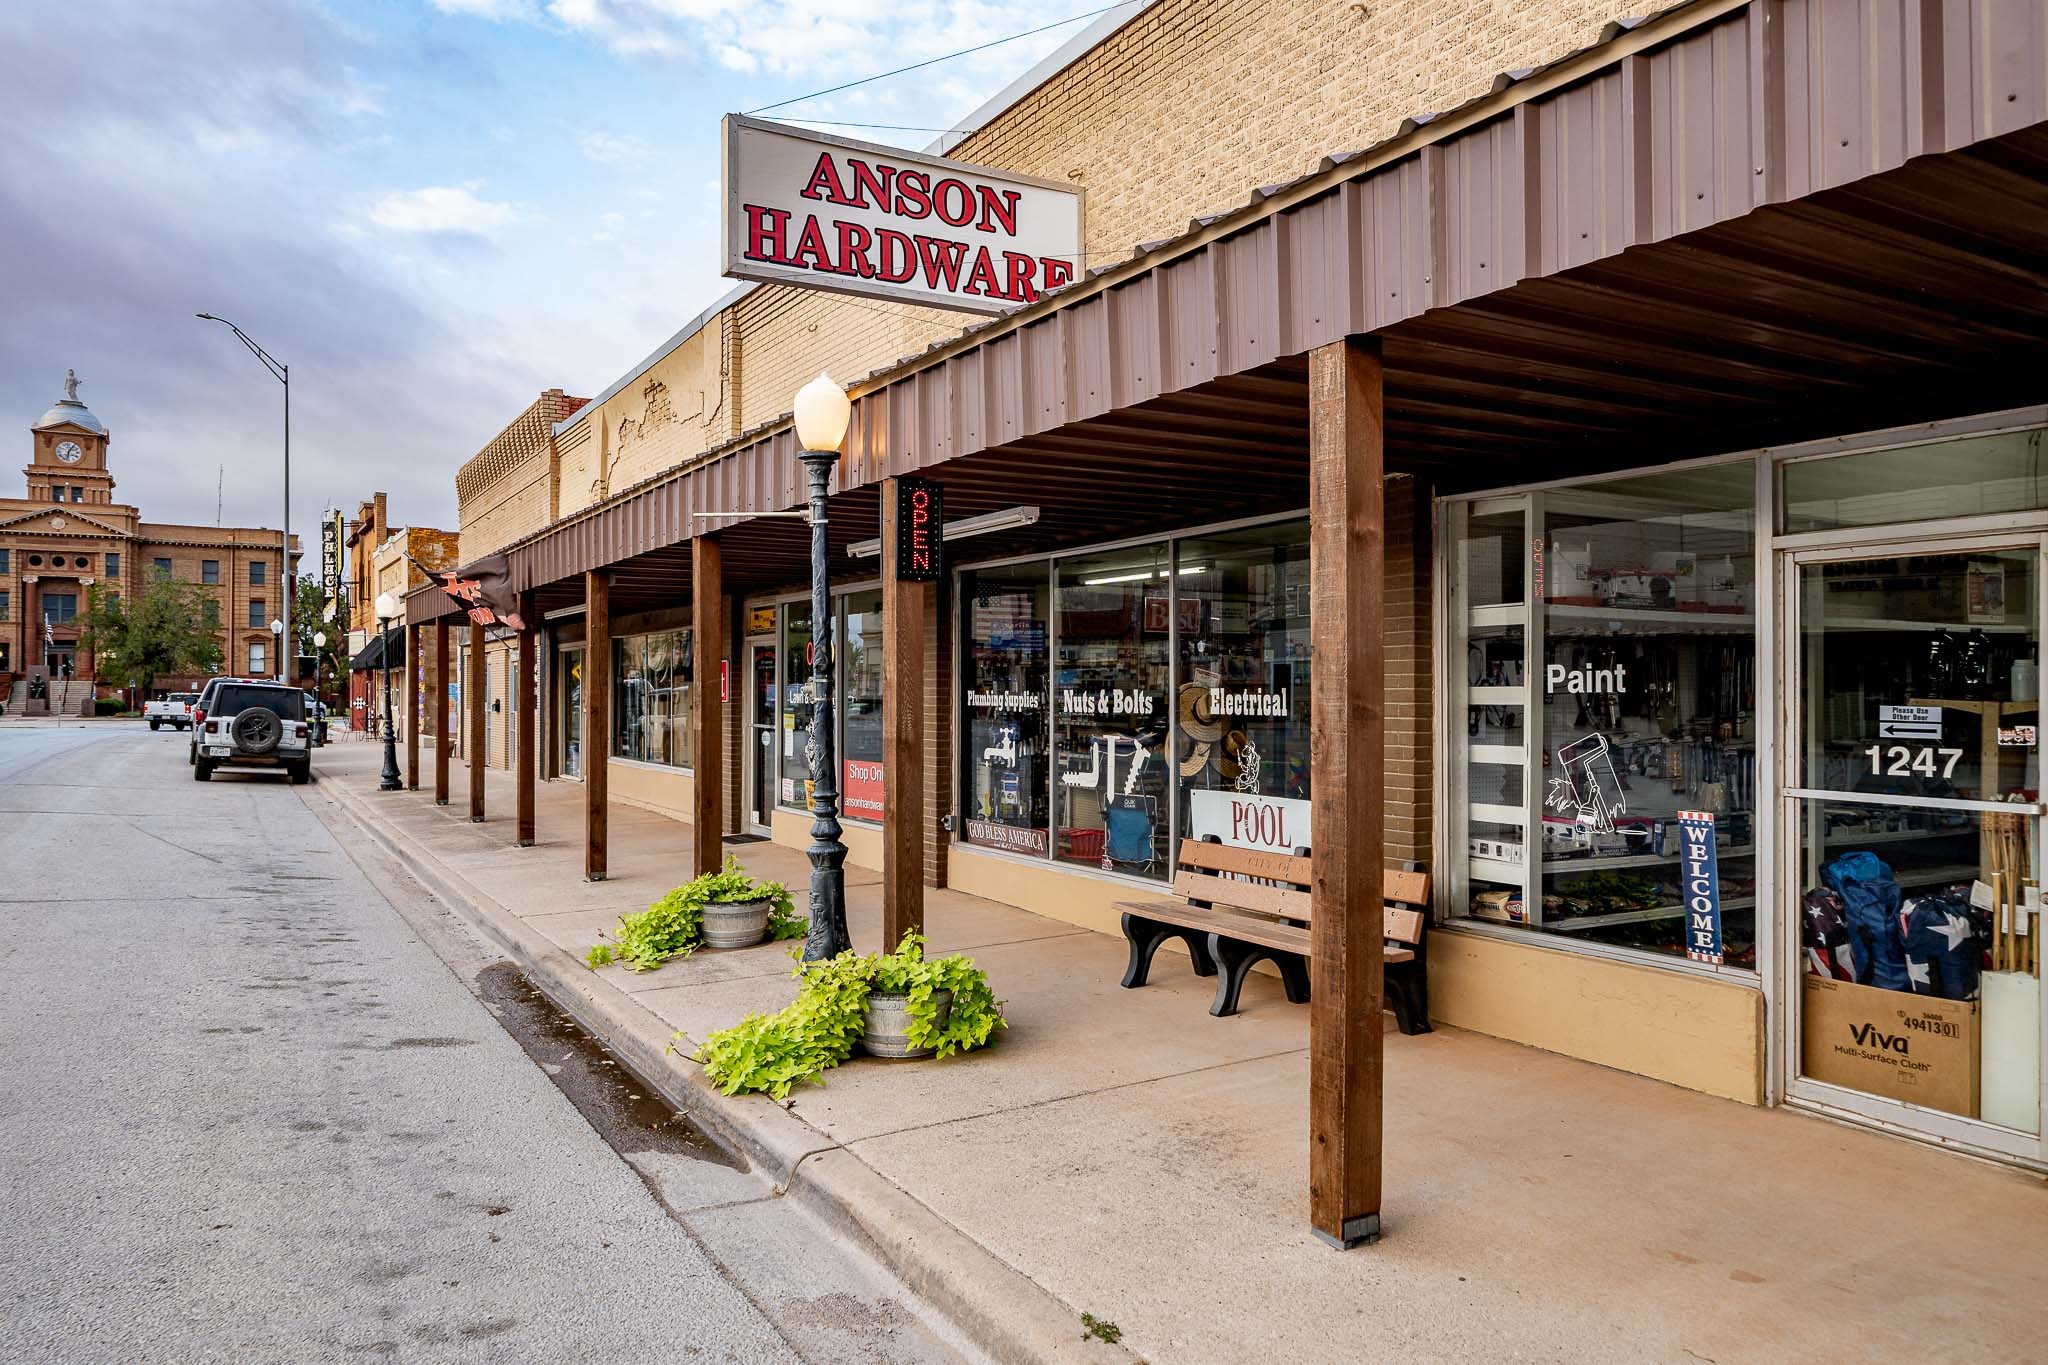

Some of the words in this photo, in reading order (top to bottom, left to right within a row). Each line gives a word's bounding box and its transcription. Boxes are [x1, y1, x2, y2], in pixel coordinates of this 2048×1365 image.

[801, 151, 1021, 236] ANSON
[912, 490, 929, 570] OPEN
[324, 531, 335, 598] PALACE
[1547, 662, 1626, 694] Paint
[967, 690, 1004, 710] Plumbing
[1004, 690, 1039, 712] Supplies
[1064, 689, 1095, 713] Nuts
[1097, 689, 1109, 714] &
[1113, 689, 1153, 714] Bolts
[1210, 688, 1287, 717] Electrical
[1892, 706, 1913, 714] Please
[1916, 707, 1929, 715] Use
[849, 763, 869, 784] Shop
[870, 766, 884, 782] Onl
[1865, 745, 1963, 779] 1247
[969, 822, 985, 838] GOD
[985, 825, 1007, 842] BLESS
[1008, 829, 1044, 851] AMERICA
[1231, 801, 1292, 848] POOL
[1686, 826, 1714, 948] WELCOME
[1849, 1022, 1908, 1054] Viva
[1904, 1017, 1941, 1034] 49413
[1943, 1023, 1956, 1038] 01
[1834, 1045, 1898, 1066] Multi-Surface
